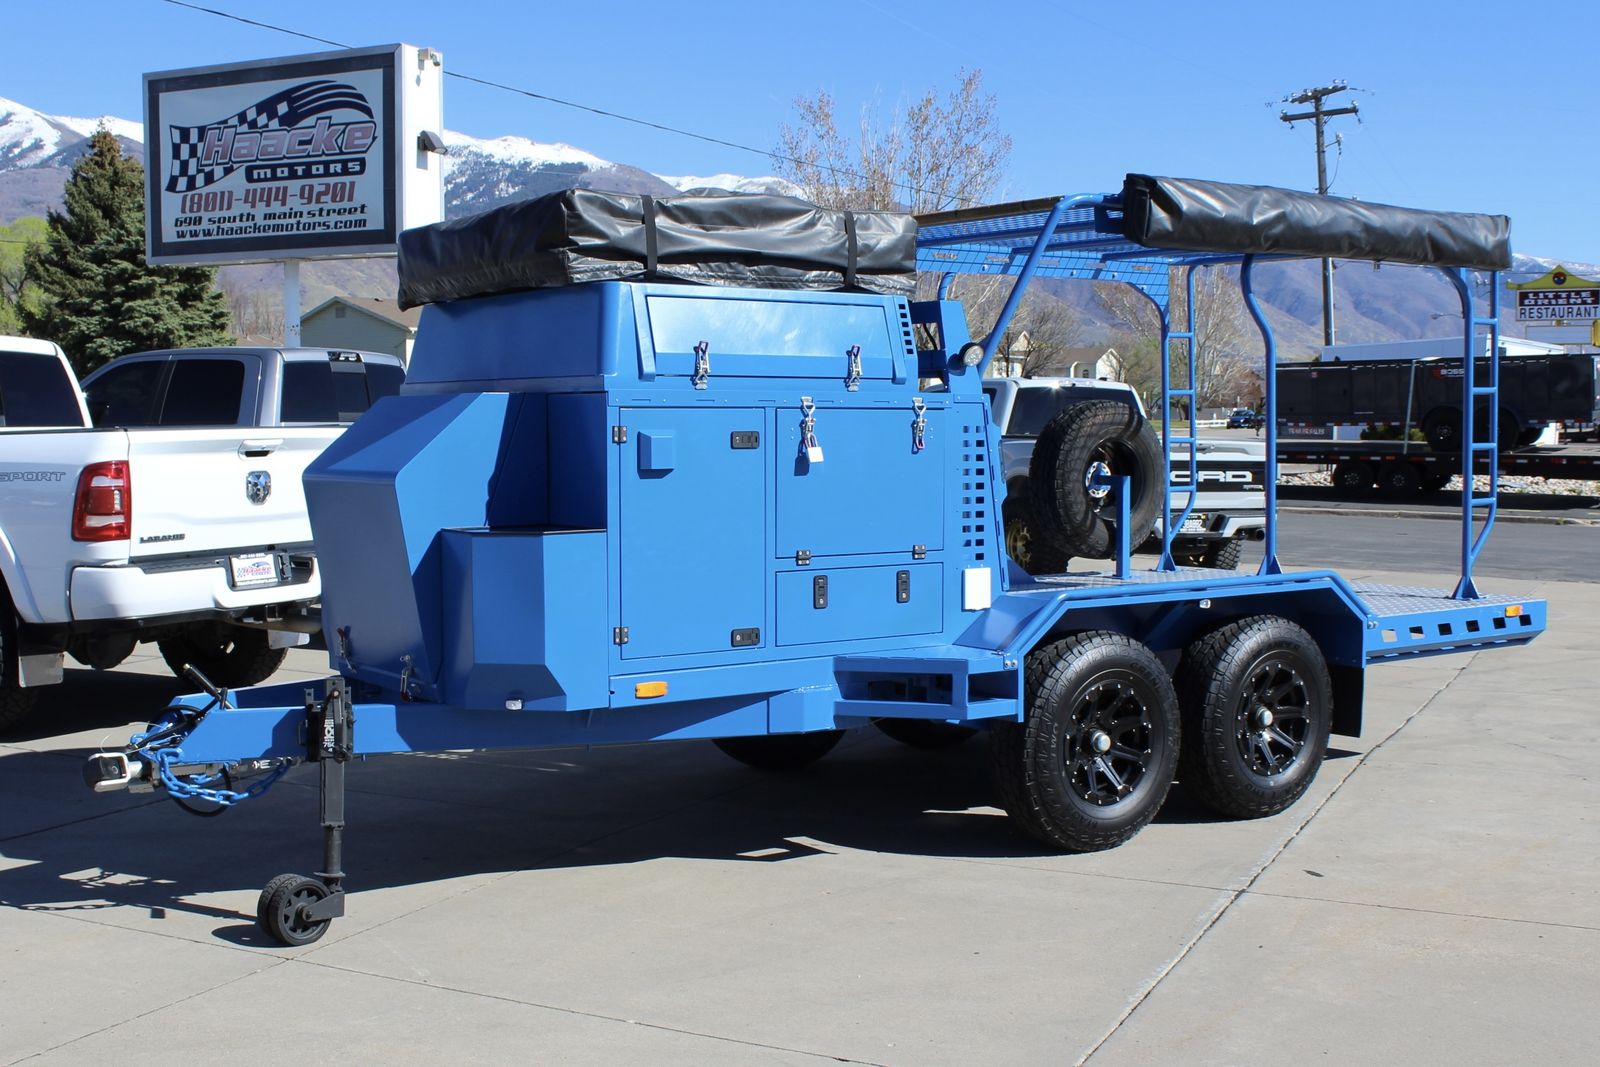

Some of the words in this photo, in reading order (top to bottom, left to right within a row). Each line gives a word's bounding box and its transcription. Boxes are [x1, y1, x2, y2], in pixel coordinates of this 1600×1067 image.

[200, 117, 376, 167] Haacke
[253, 161, 361, 180] MOTORS
[180, 181, 357, 214] (801)-444-9201
[207, 212, 256, 225] south
[263, 207, 304, 221] main
[306, 203, 368, 218] street
[176, 218, 367, 239] www.haackemotors.com
[1524, 297, 1595, 305] ORIENT
[1528, 291, 1593, 299] LITTLE
[1519, 306, 1599, 319] RESTAURANT
[1170, 465, 1253, 482] ORD
